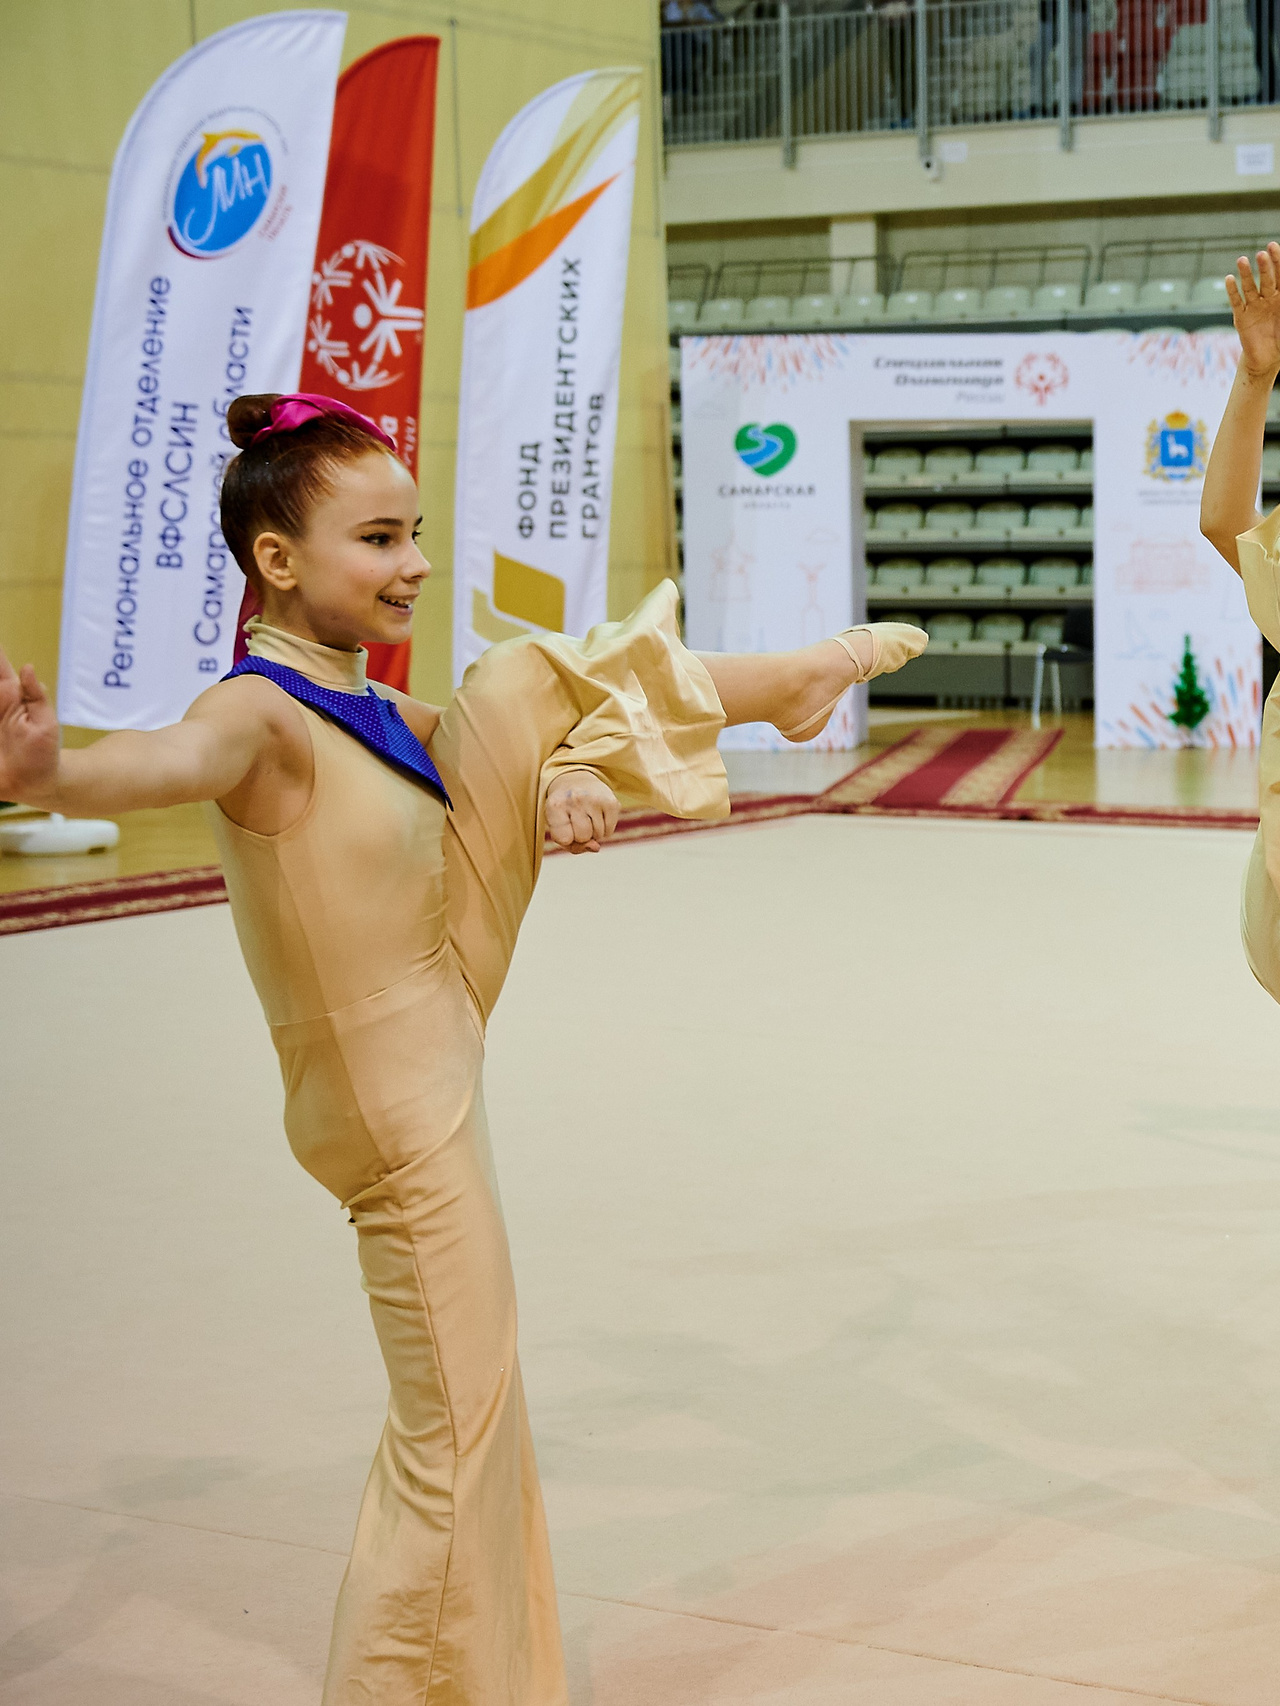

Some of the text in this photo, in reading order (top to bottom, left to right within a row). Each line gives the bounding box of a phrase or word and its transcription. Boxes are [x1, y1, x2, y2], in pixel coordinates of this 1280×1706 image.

[550, 258, 581, 539] ПРЕЗИДЕНТСКИХ
[581, 393, 604, 539] ГРАНТОВ
[103, 276, 171, 689] Региональное отделение
[156, 402, 199, 570] ВФСЛСИН
[518, 441, 542, 538] ФОНД
[198, 657, 219, 673] в
